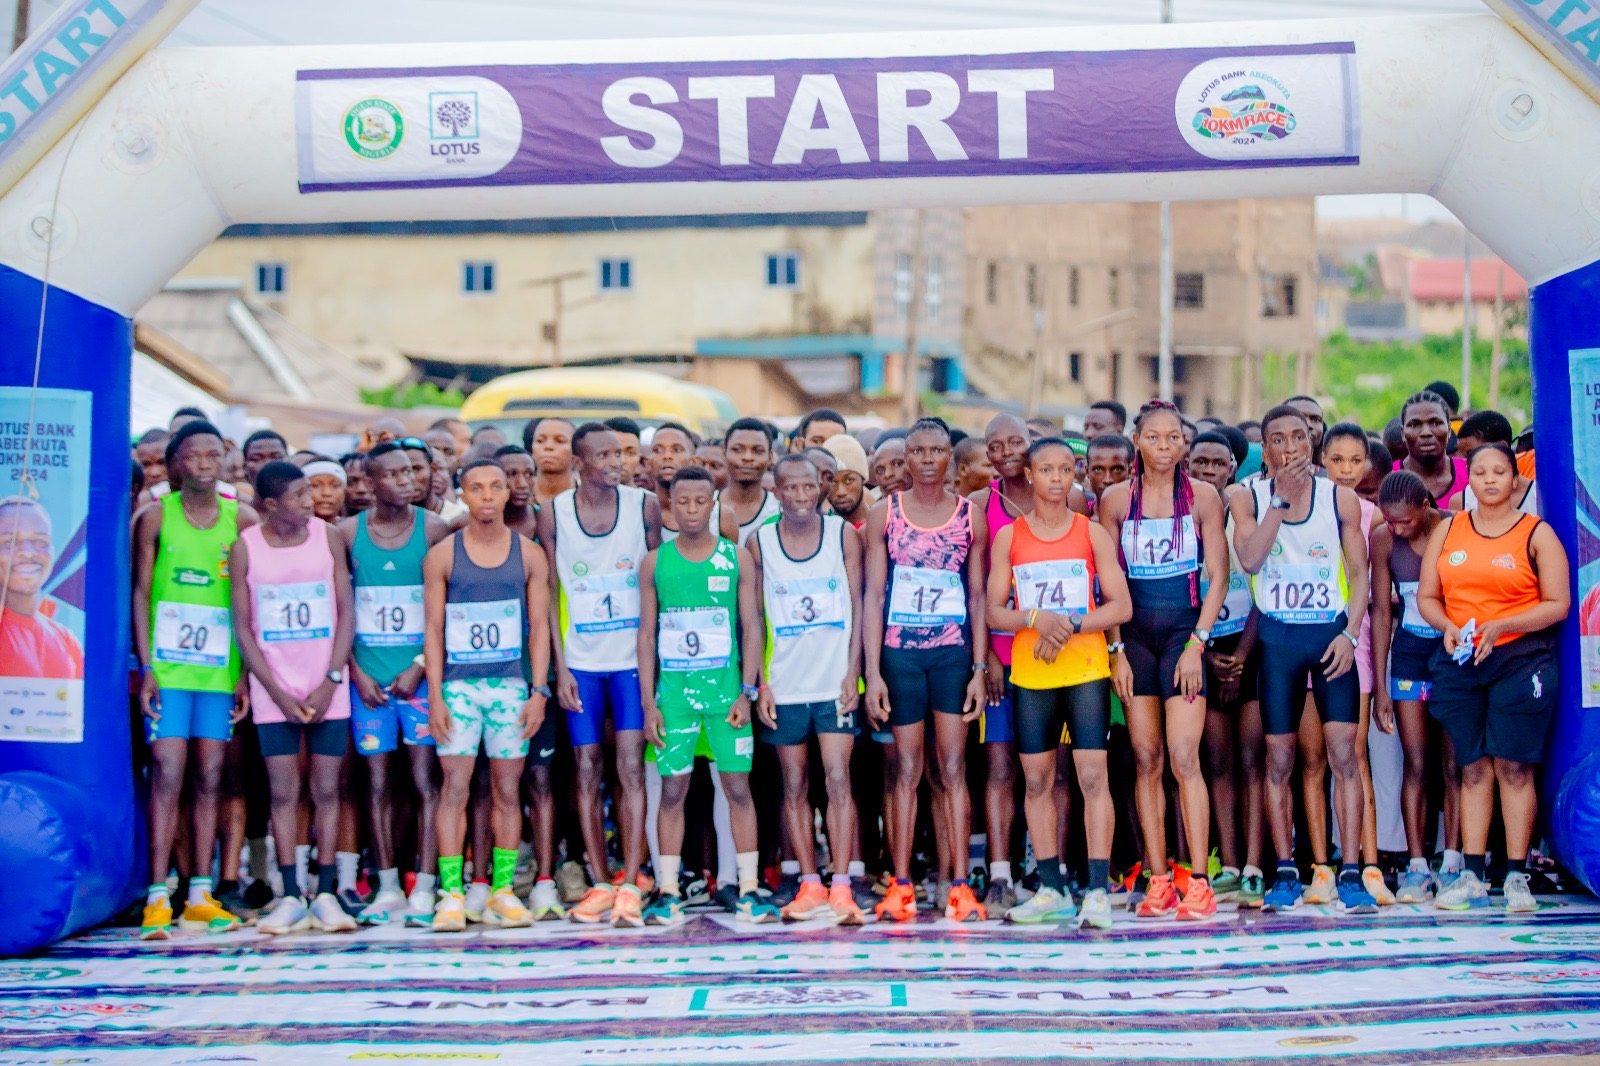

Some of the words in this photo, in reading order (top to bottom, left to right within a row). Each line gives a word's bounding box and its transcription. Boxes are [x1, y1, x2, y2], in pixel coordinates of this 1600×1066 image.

[1198, 78, 1220, 103] LOTUS
[1221, 70, 1247, 82] BANK
[1249, 70, 1291, 101] ABEOKUTA
[600, 68, 1055, 169] START
[1244, 111, 1288, 128] RACE
[430, 143, 480, 156] LOTUS
[1232, 137, 1255, 145] 2024
[36, 423, 75, 437] BANK
[33, 454, 69, 467] RACE
[1144, 538, 1174, 565] 12
[602, 593, 612, 619] 1
[913, 585, 943, 613] 17
[1035, 580, 1066, 608] 74
[1270, 582, 1330, 610] 1023
[280, 602, 310, 628] 10
[376, 606, 404, 632] 19
[801, 596, 816, 623] 3
[179, 623, 208, 651] 20
[470, 623, 499, 650] 80
[686, 631, 700, 657] 9
[365, 996, 648, 1010] BANK
[952, 985, 1288, 1000] LOTUS
